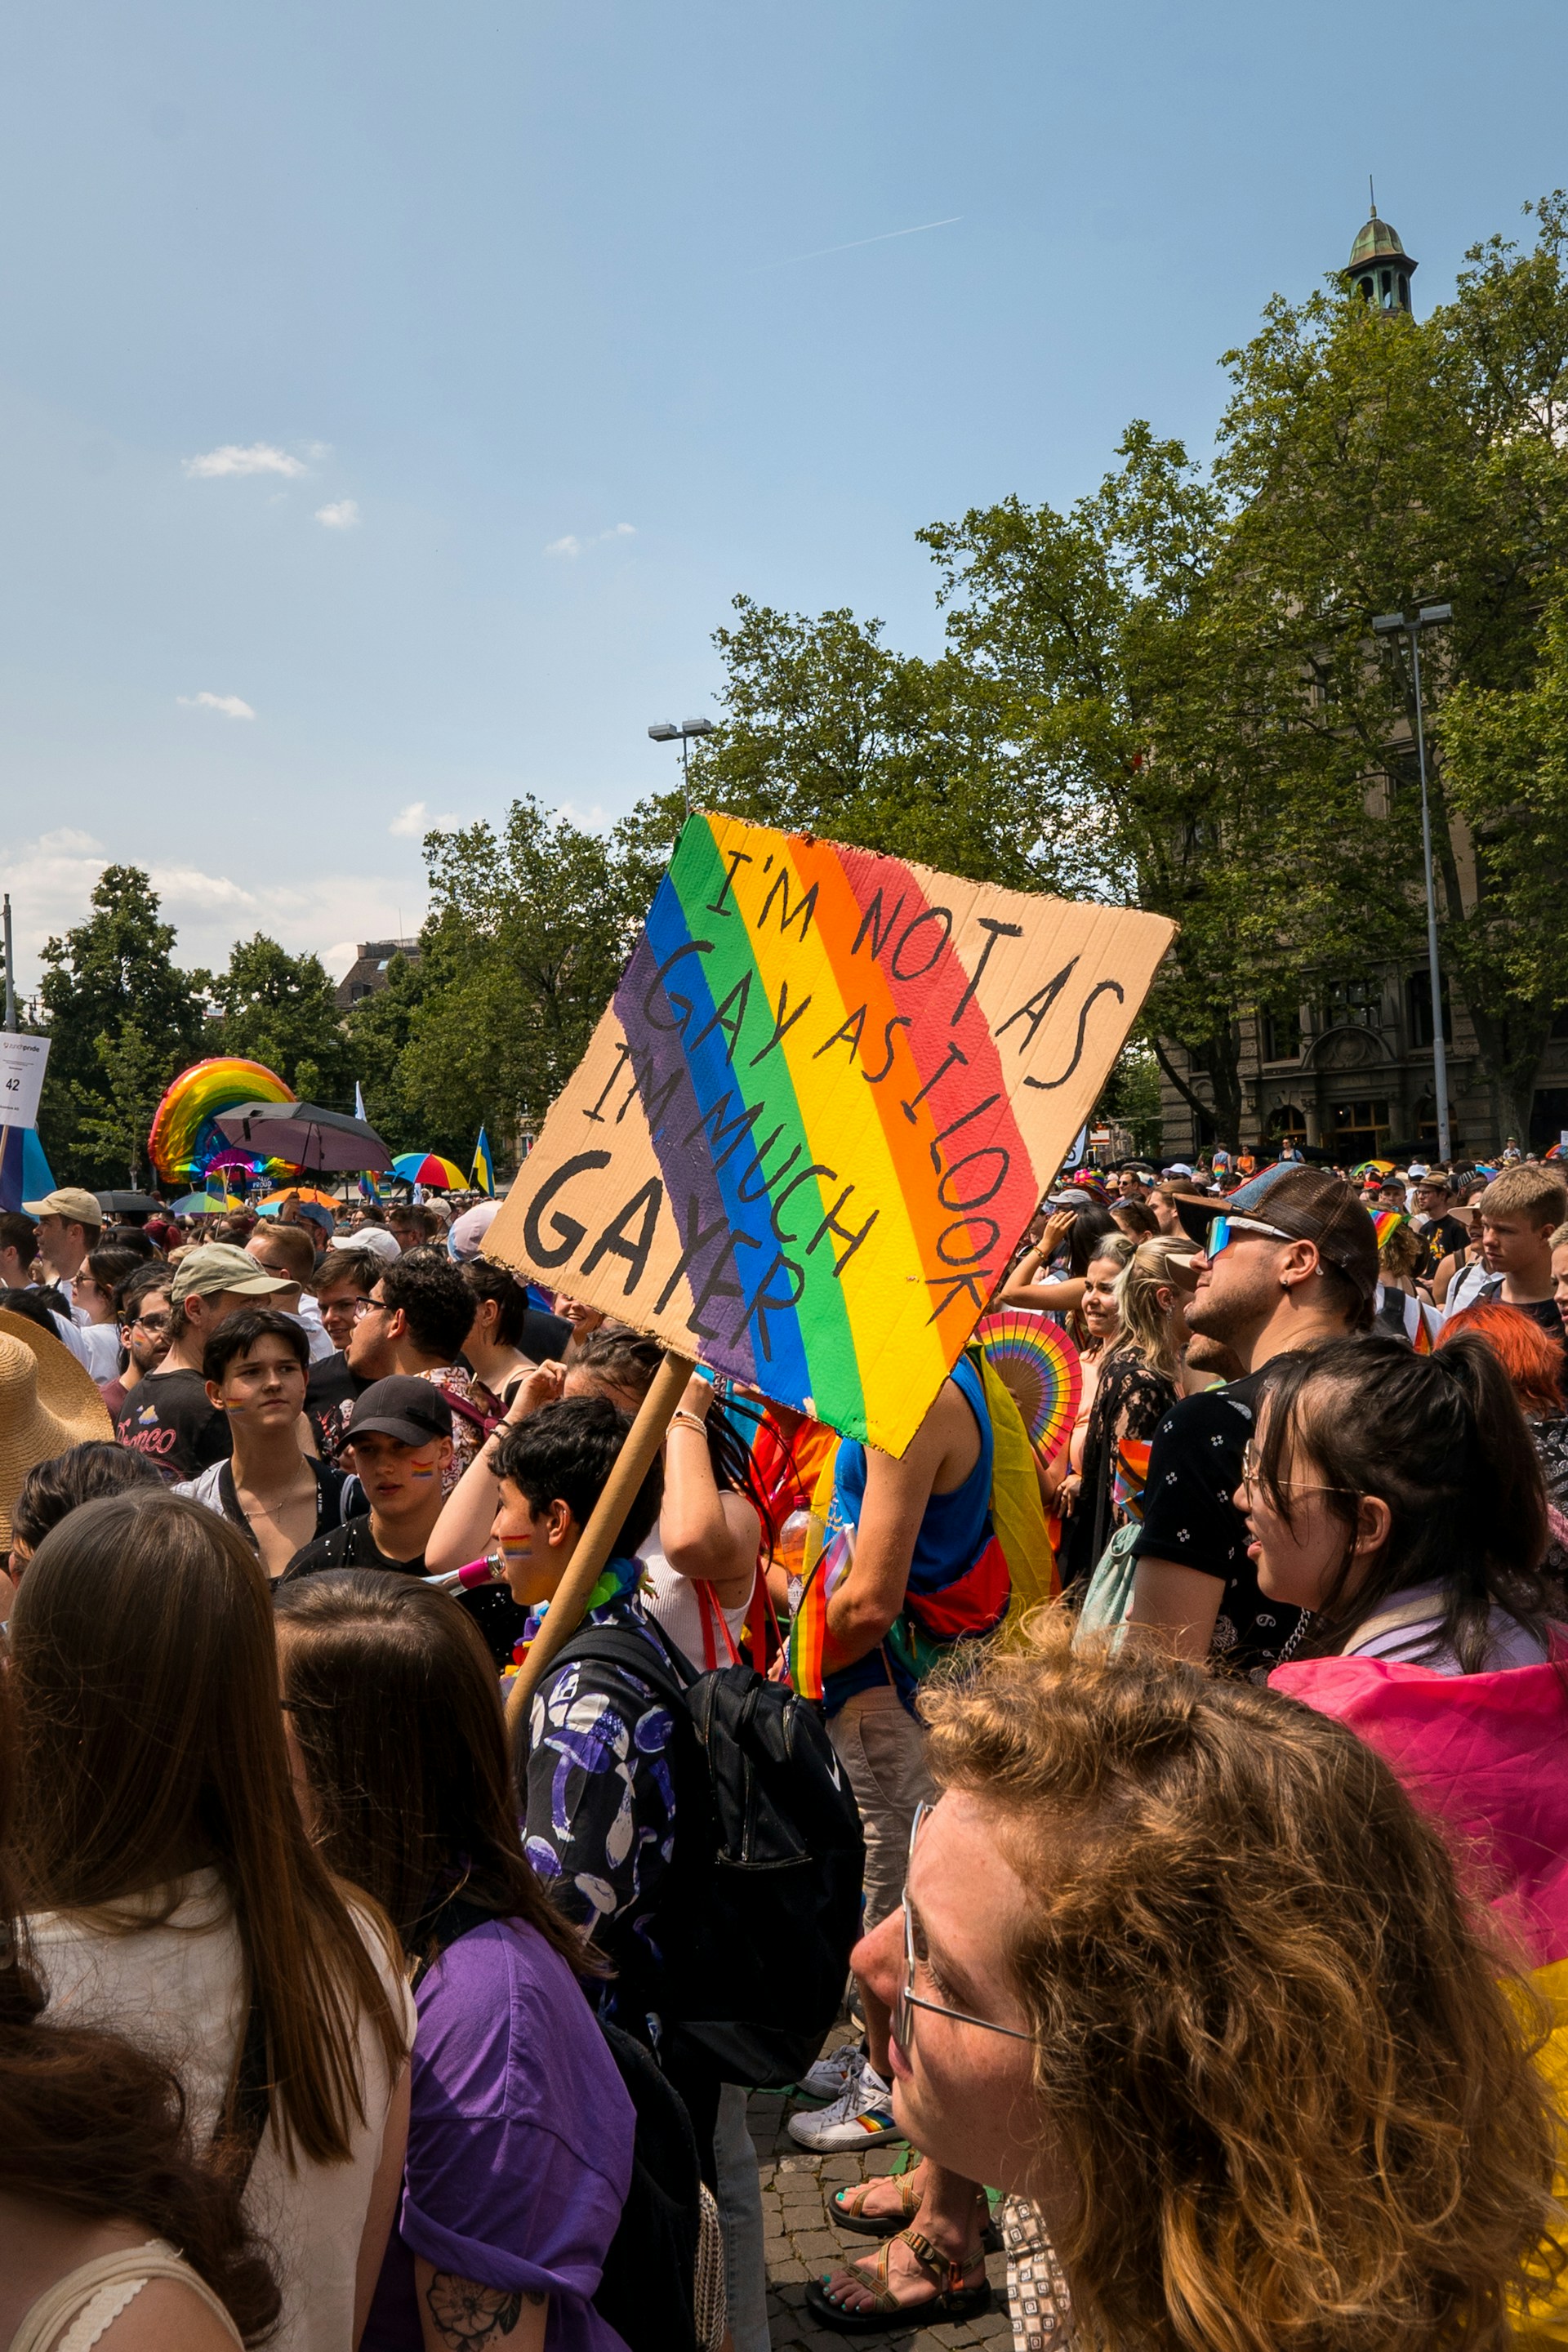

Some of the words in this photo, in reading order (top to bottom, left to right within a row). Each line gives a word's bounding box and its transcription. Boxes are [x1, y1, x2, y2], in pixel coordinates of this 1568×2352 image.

[644, 941, 812, 1067] GAY
[706, 850, 819, 942] I'M
[851, 888, 1023, 1026] NOT
[996, 956, 1125, 1090] AS
[6, 1078, 20, 1091] 42
[813, 1004, 911, 1084] AS
[901, 1042, 969, 1125] I
[252, 1180, 272, 1188] PROUD
[680, 1089, 879, 1277] MUCH
[924, 1094, 1009, 1326] LOOK
[523, 1151, 804, 1362] GAYER
